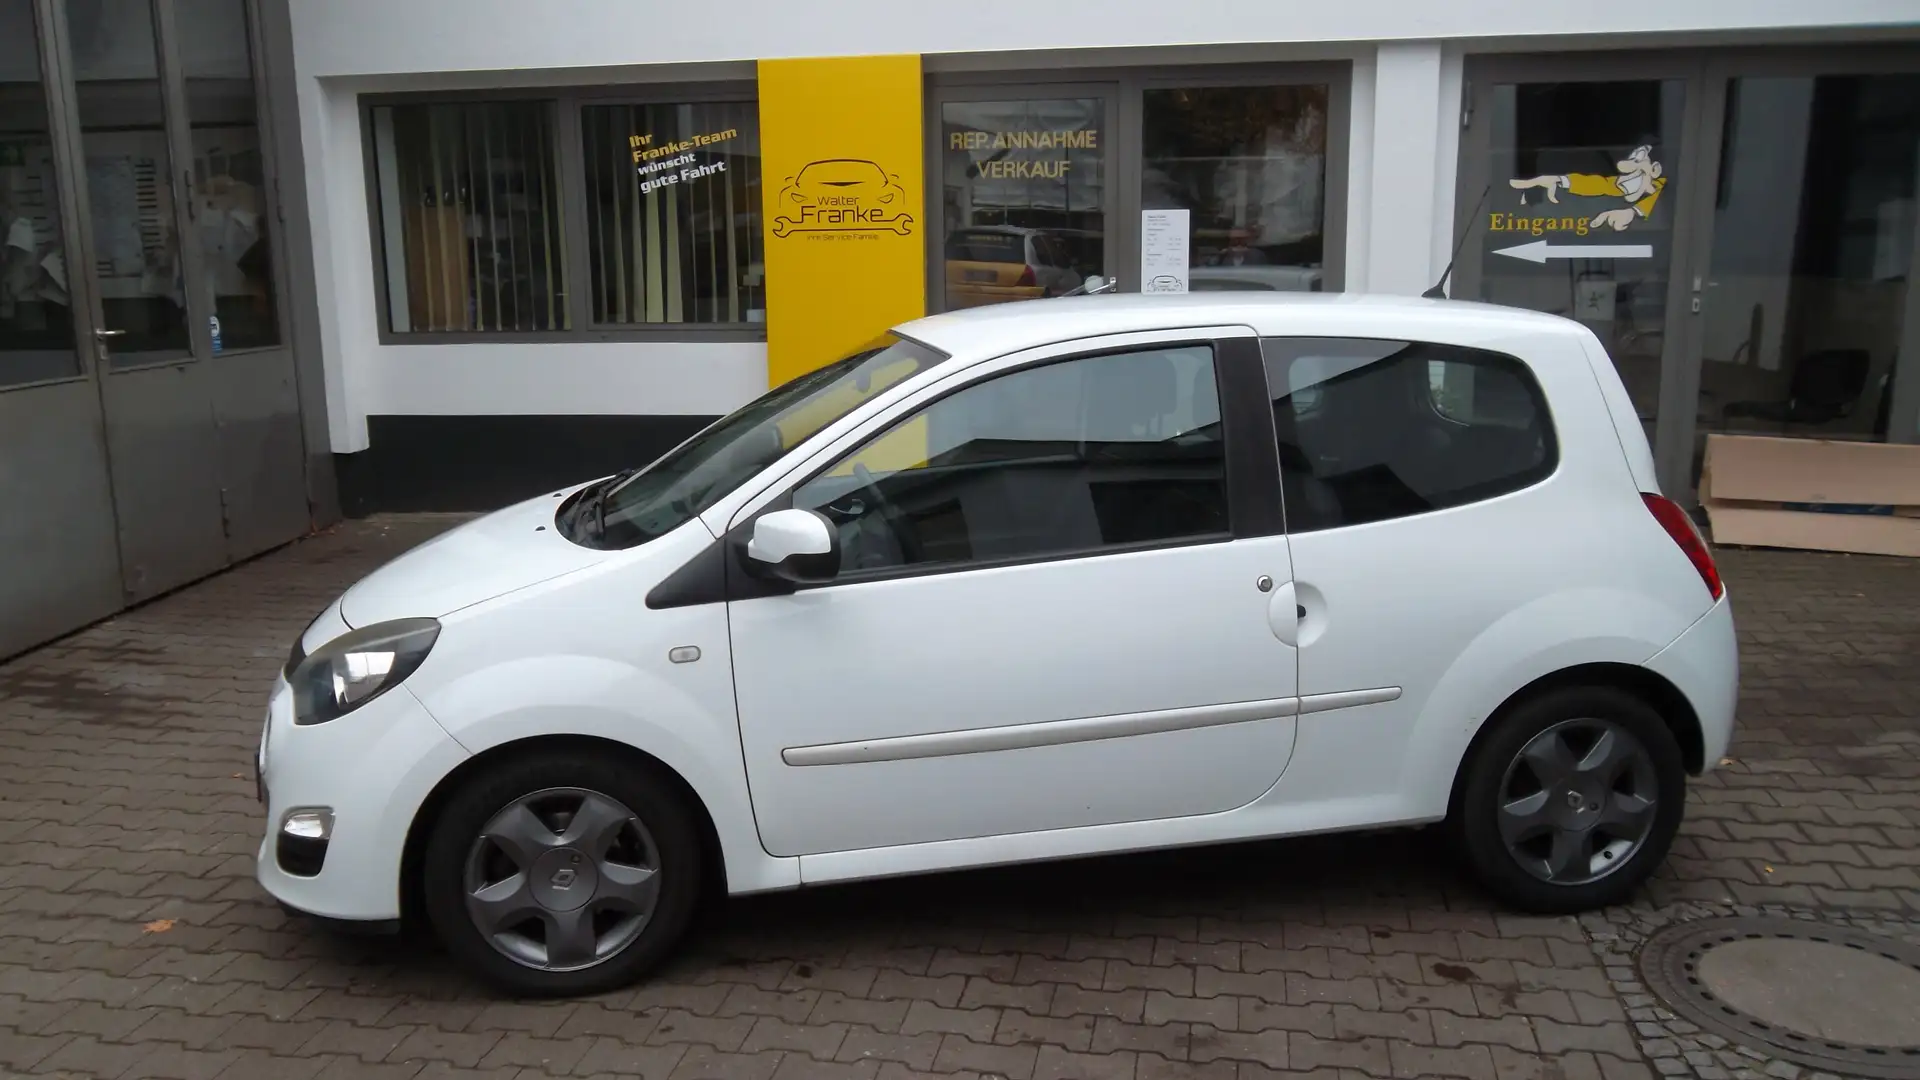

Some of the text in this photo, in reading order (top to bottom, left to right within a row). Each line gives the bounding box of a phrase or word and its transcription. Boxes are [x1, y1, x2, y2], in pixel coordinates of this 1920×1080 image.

[629, 134, 652, 147] Ihr
[632, 128, 737, 163] Franke-Team
[638, 153, 696, 175] wünscht
[977, 160, 1070, 178] VERKAUF
[640, 161, 727, 194] gute Fahrt
[817, 196, 860, 206] Walter
[801, 205, 883, 223] Franke
[1489, 213, 1590, 236] Eingang
